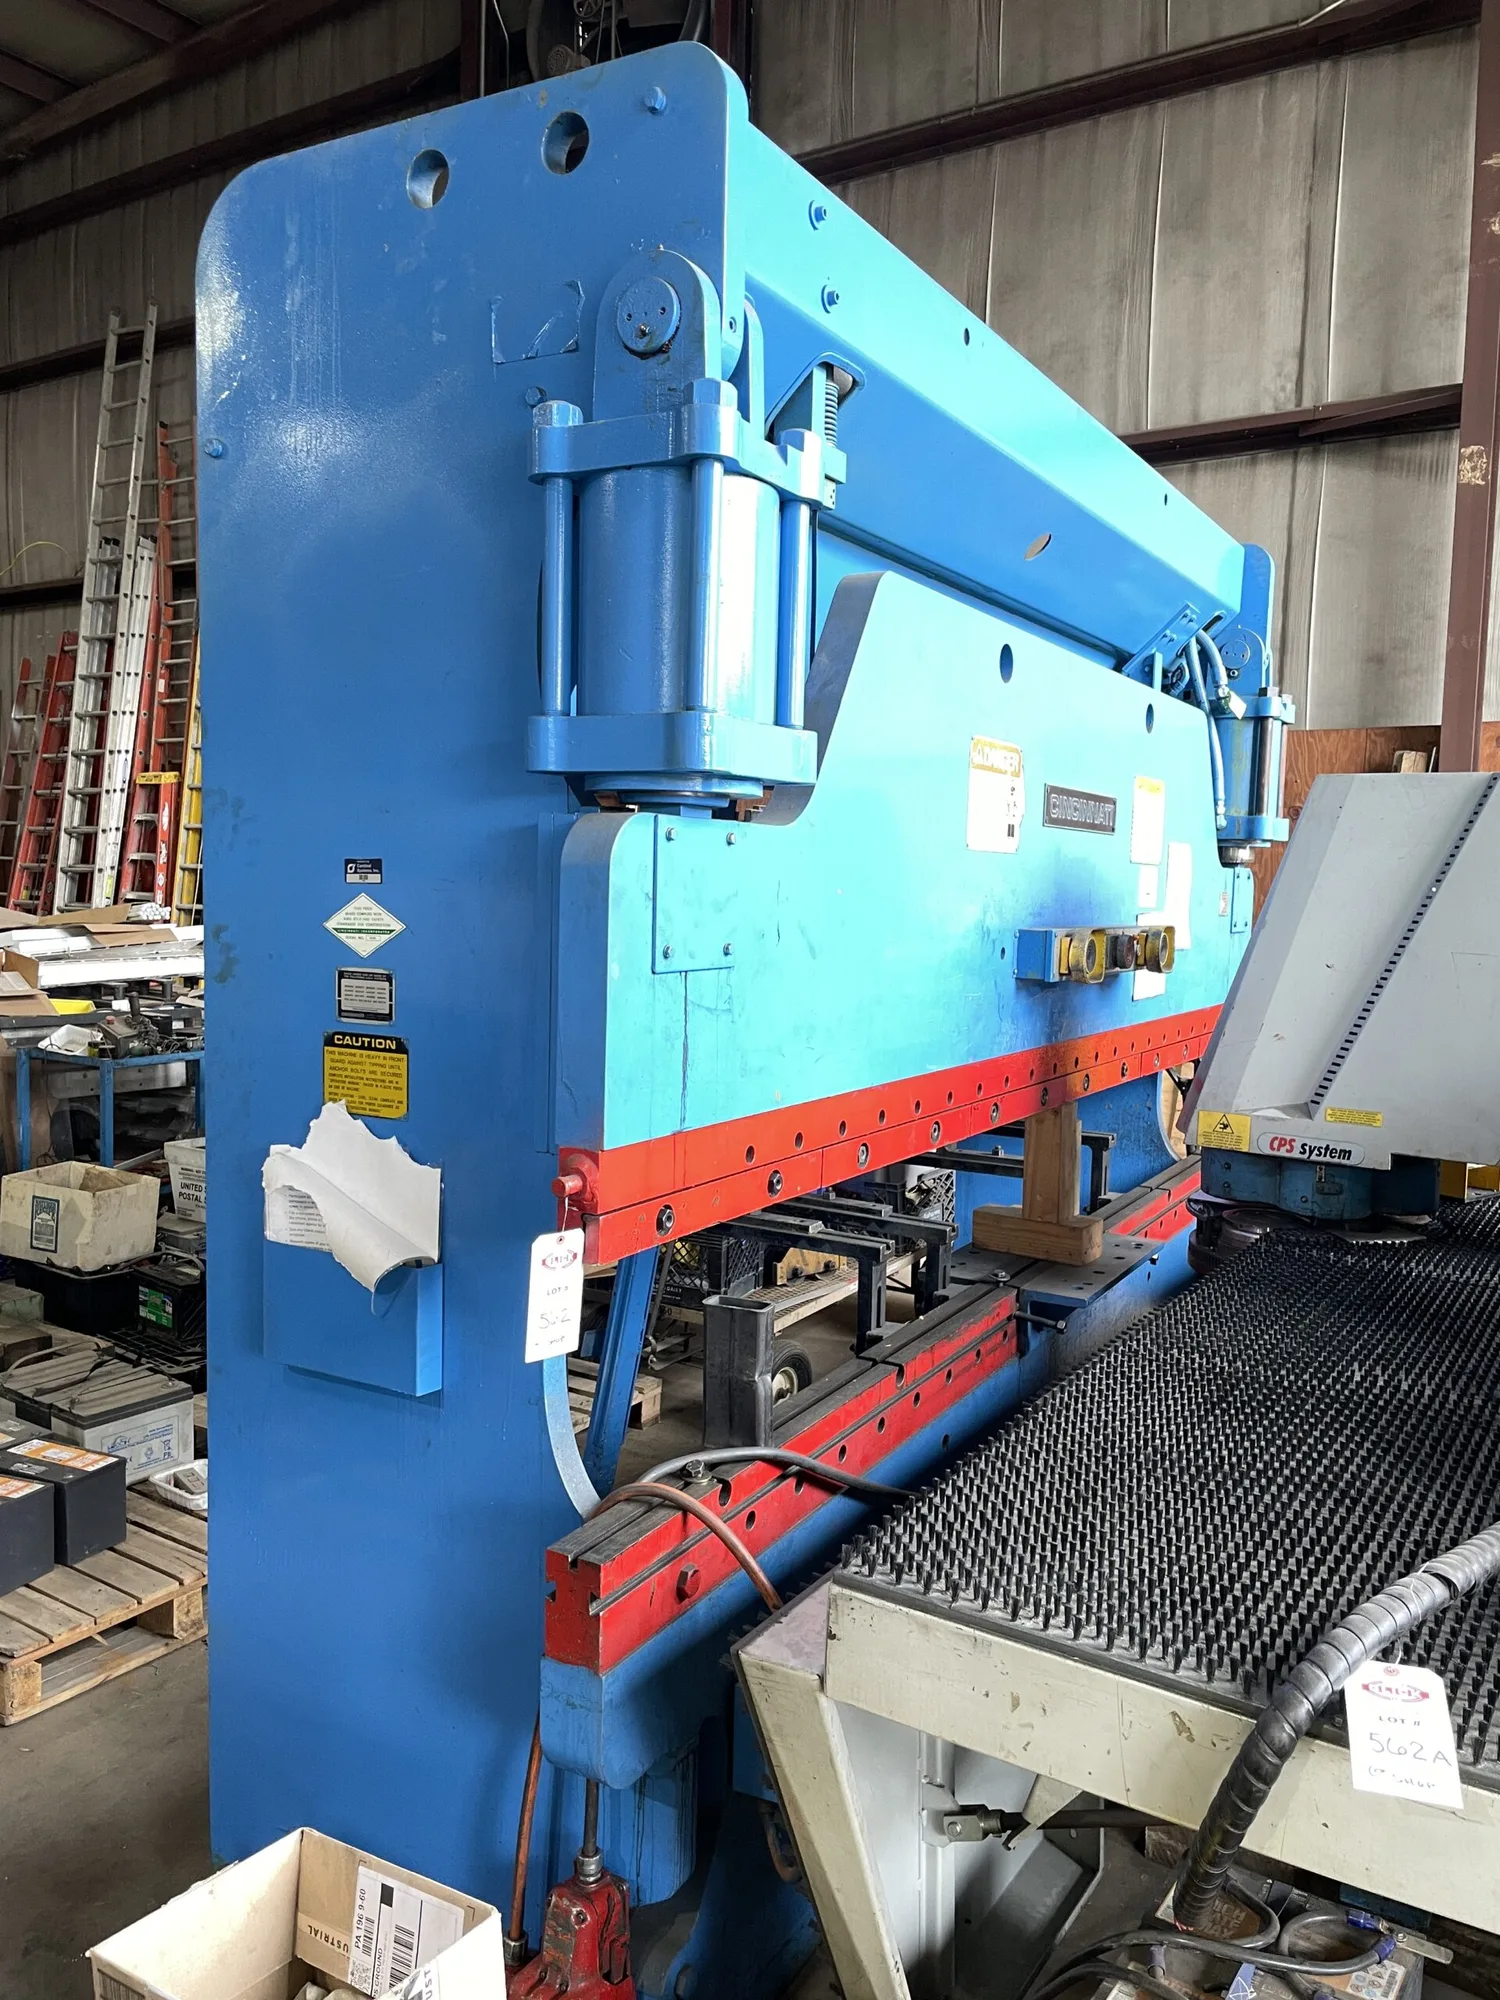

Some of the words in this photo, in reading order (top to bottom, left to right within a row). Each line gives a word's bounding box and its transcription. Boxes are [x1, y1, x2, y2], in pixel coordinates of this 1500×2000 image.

[1050, 793, 1115, 827] CINCINNATI
[334, 1034, 396, 1049] CAUTION
[1269, 1136, 1296, 1154] CPS
[1299, 1142, 1353, 1162] system
[180, 1181, 204, 1193] UNITED
[178, 1191, 203, 1203] POSTAL
[546, 1286, 562, 1296] LOT
[1378, 1715, 1406, 1725] LOT
[1369, 1732, 1452, 1767] 562A
[358, 1888, 367, 1912] 9-60
[356, 1914, 365, 1932] 196
[354, 1934, 363, 1950] PA
[374, 1947, 383, 1987] GROUND
